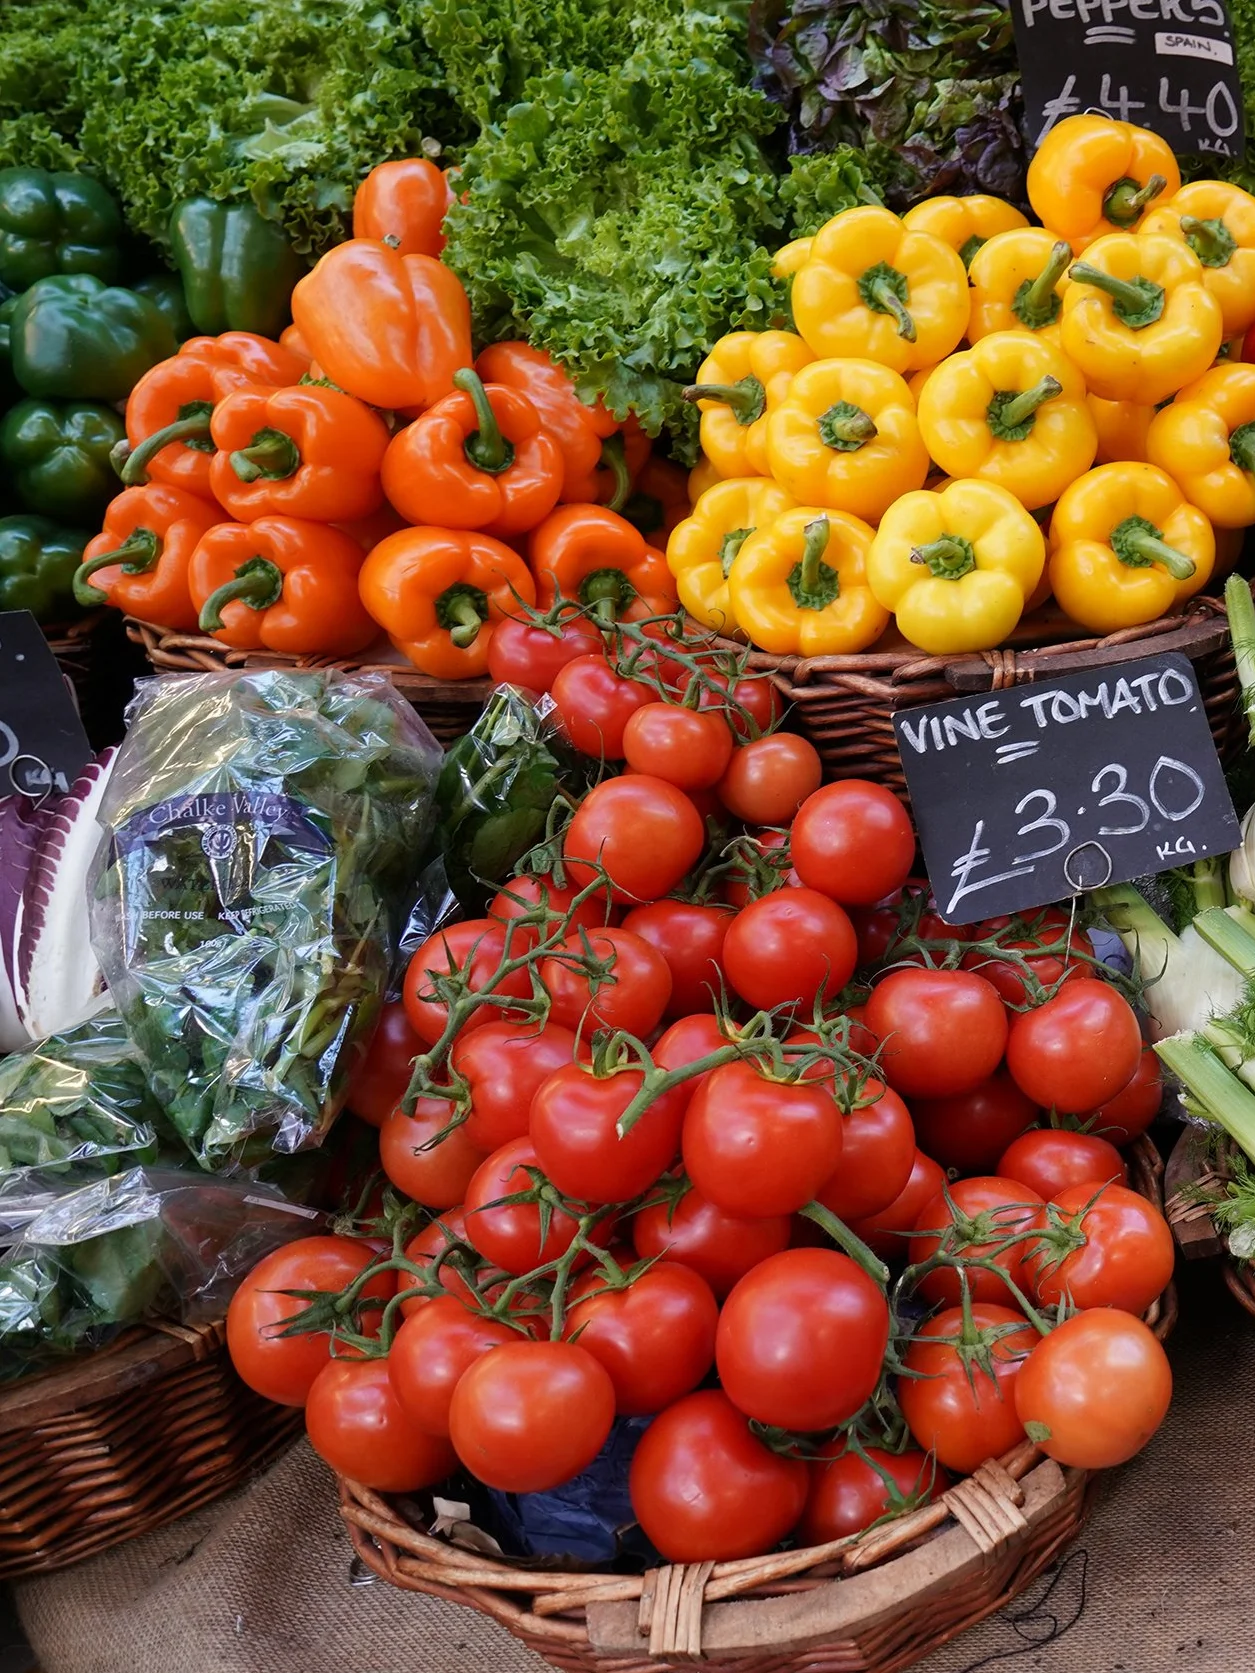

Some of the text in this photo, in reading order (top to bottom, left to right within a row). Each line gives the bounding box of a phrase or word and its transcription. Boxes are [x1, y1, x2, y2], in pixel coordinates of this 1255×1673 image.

[900, 701, 1011, 753] VINE
[149, 792, 288, 824] Chalke Valley
[945, 756, 1206, 914] £3.30
[142, 911, 181, 920] BEFORE
[184, 911, 204, 920] USE
